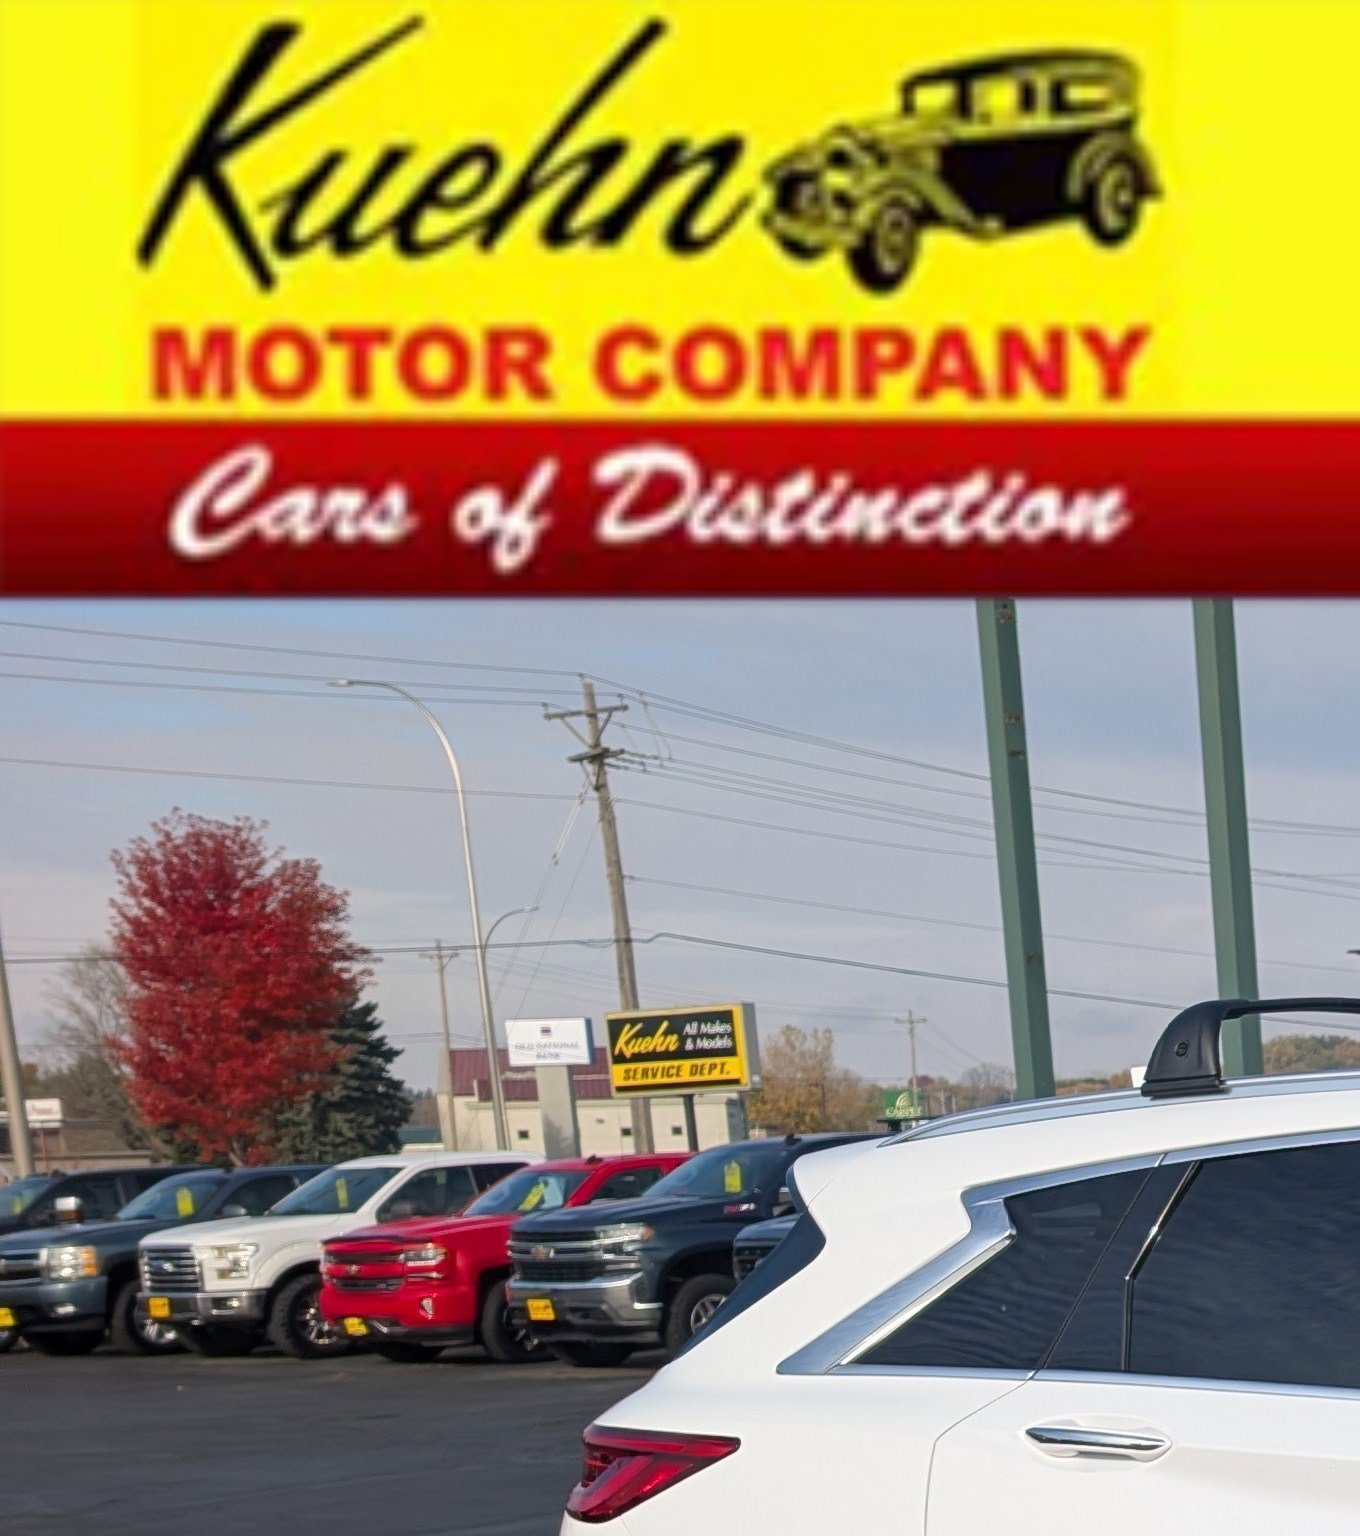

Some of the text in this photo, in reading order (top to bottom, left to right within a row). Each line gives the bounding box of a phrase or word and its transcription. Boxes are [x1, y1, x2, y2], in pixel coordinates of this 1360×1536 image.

[614, 1019, 732, 1059] Kuehn All Makes
[695, 1035, 733, 1050] Models
[623, 1060, 731, 1081] SERVICE DEPT.
